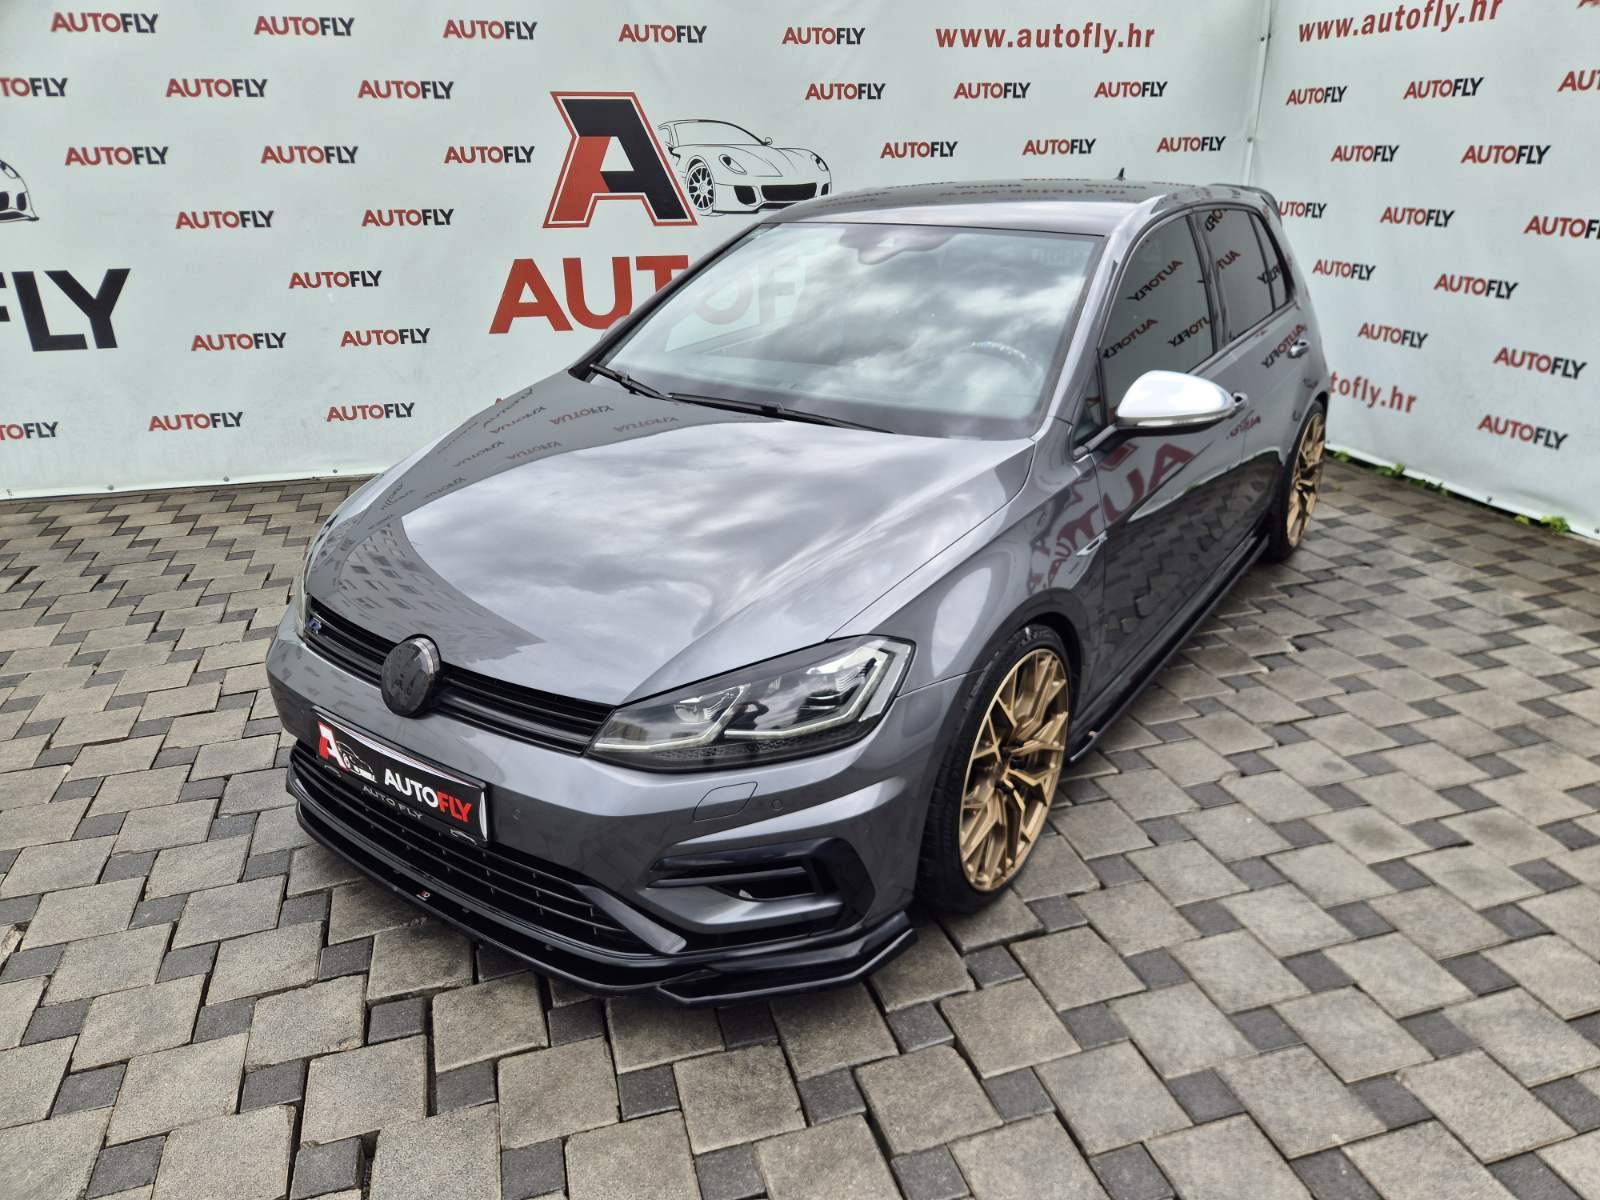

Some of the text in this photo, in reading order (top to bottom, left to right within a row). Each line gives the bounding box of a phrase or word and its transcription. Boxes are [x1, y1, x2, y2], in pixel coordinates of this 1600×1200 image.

[52, 13, 158, 33] AUTOFLY
[255, 16, 354, 36] AUTOFLY
[444, 21, 537, 39] AUTOFLY
[1300, 0, 1502, 41] www.autofly.hr
[619, 24, 706, 43] AUTOFLY
[783, 28, 865, 44] AUTOFLY
[936, 23, 1154, 53] www.autofly.hr
[167, 79, 267, 97] AUTOFLY
[359, 80, 453, 99] AUTOFLY
[955, 83, 1030, 98] AUTOFLY
[1095, 82, 1167, 97] AUTOFLY
[1404, 77, 1483, 99] AUTOFLY
[1559, 71, 1600, 91] AU
[806, 84, 885, 100] AUTOFLY
[1287, 86, 1347, 105] AUTOFLY
[881, 142, 957, 158] AUTOFLY
[1023, 139, 1096, 155] AUTOFLY
[1157, 136, 1226, 152] AUTOFLY
[66, 147, 168, 164] AUTOFLY
[263, 145, 358, 164] AUTOFLY
[445, 146, 534, 163] AUTOFLY
[1332, 146, 1399, 162] AUTOFLY
[1462, 145, 1550, 164] AUTOFLY
[176, 211, 273, 228] AUTOFLY
[363, 209, 454, 226] AUTOFLY
[1381, 208, 1454, 227] AUTOFLY
[1525, 216, 1600, 239] AUTOF
[290, 271, 382, 288] AUTOFLY
[1313, 260, 1375, 280] AUTOFLY
[1435, 275, 1518, 299] AUTOFLY
[192, 333, 286, 351] AUTOFLY
[342, 328, 430, 346] AUTOFLY
[1359, 324, 1427, 348] AUTOFLY
[1495, 348, 1586, 379] AUTOFLY
[150, 412, 243, 431] AUTOFLY
[327, 403, 414, 421] AUTOFLY
[1479, 416, 1567, 449] AUTOFLY
[384, 768, 472, 822] AUTOFLY
